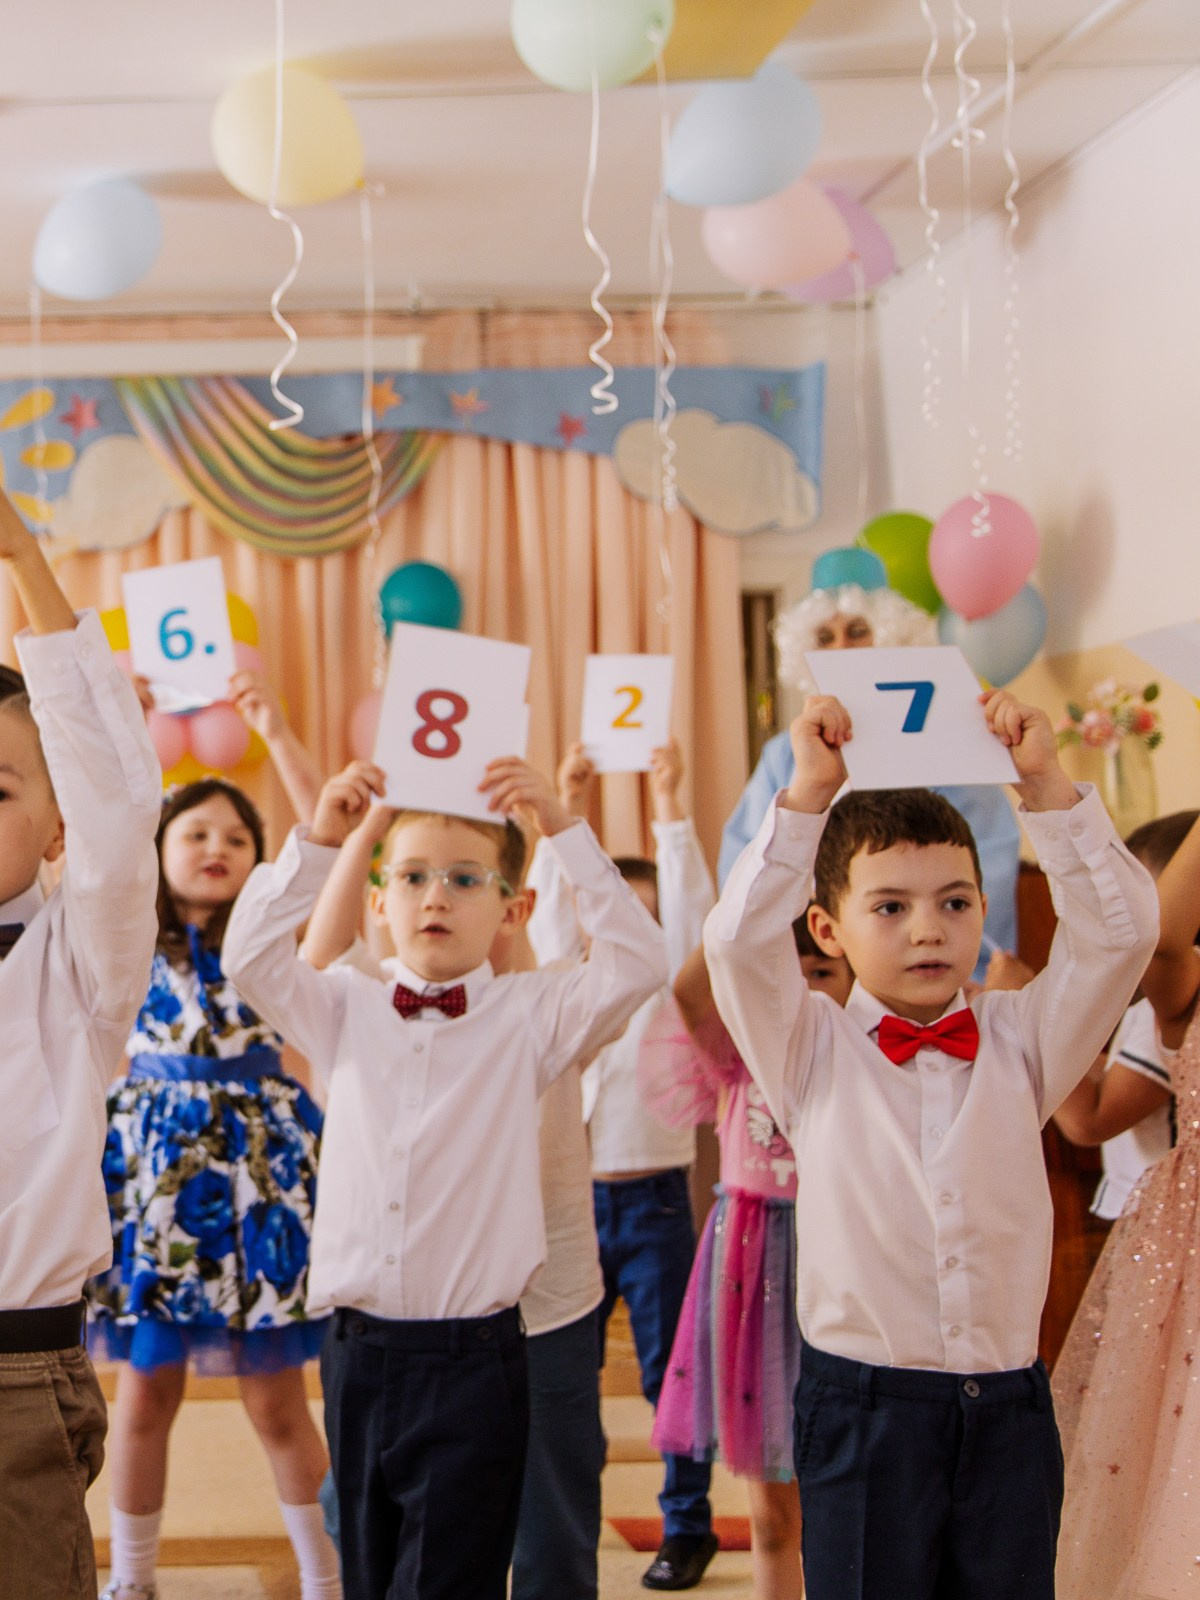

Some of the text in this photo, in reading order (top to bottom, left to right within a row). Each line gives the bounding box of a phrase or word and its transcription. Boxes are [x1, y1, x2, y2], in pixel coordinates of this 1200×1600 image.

[159, 607, 216, 660] 6.
[412, 689, 469, 759] 8
[612, 686, 644, 728] 2
[875, 681, 936, 733] 7
